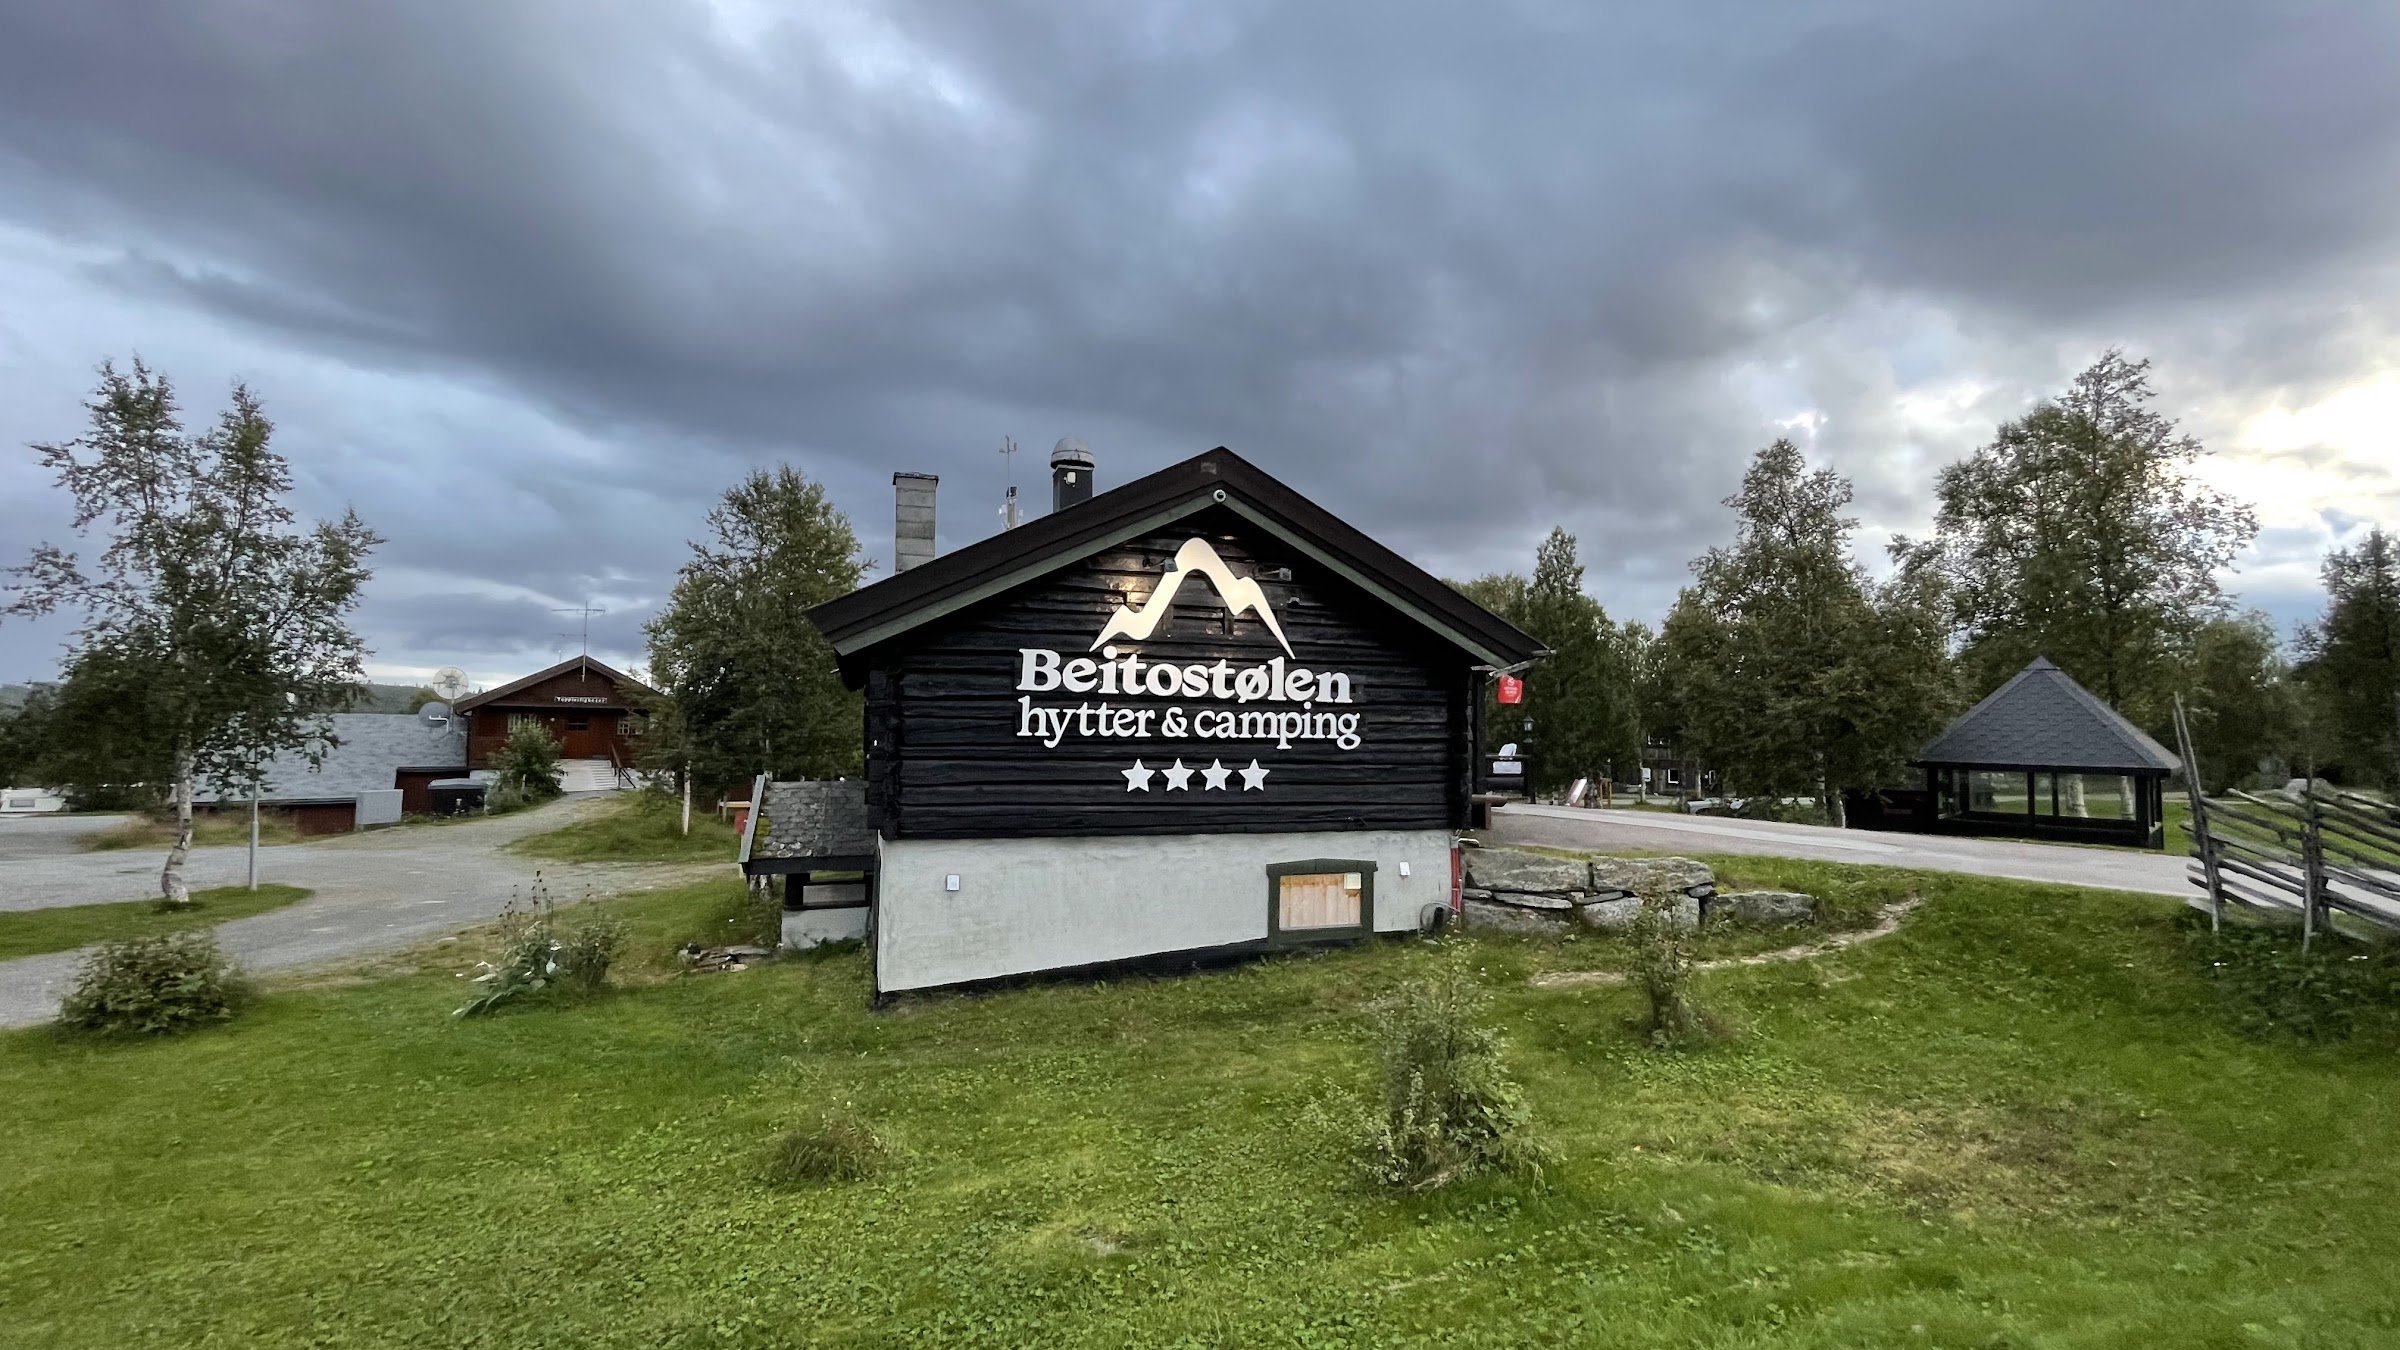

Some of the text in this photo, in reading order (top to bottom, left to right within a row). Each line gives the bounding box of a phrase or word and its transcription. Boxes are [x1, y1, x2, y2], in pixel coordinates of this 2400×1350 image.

[1016, 645, 1354, 703] Beitostølen
[1017, 695, 1361, 751] hytter & camping
